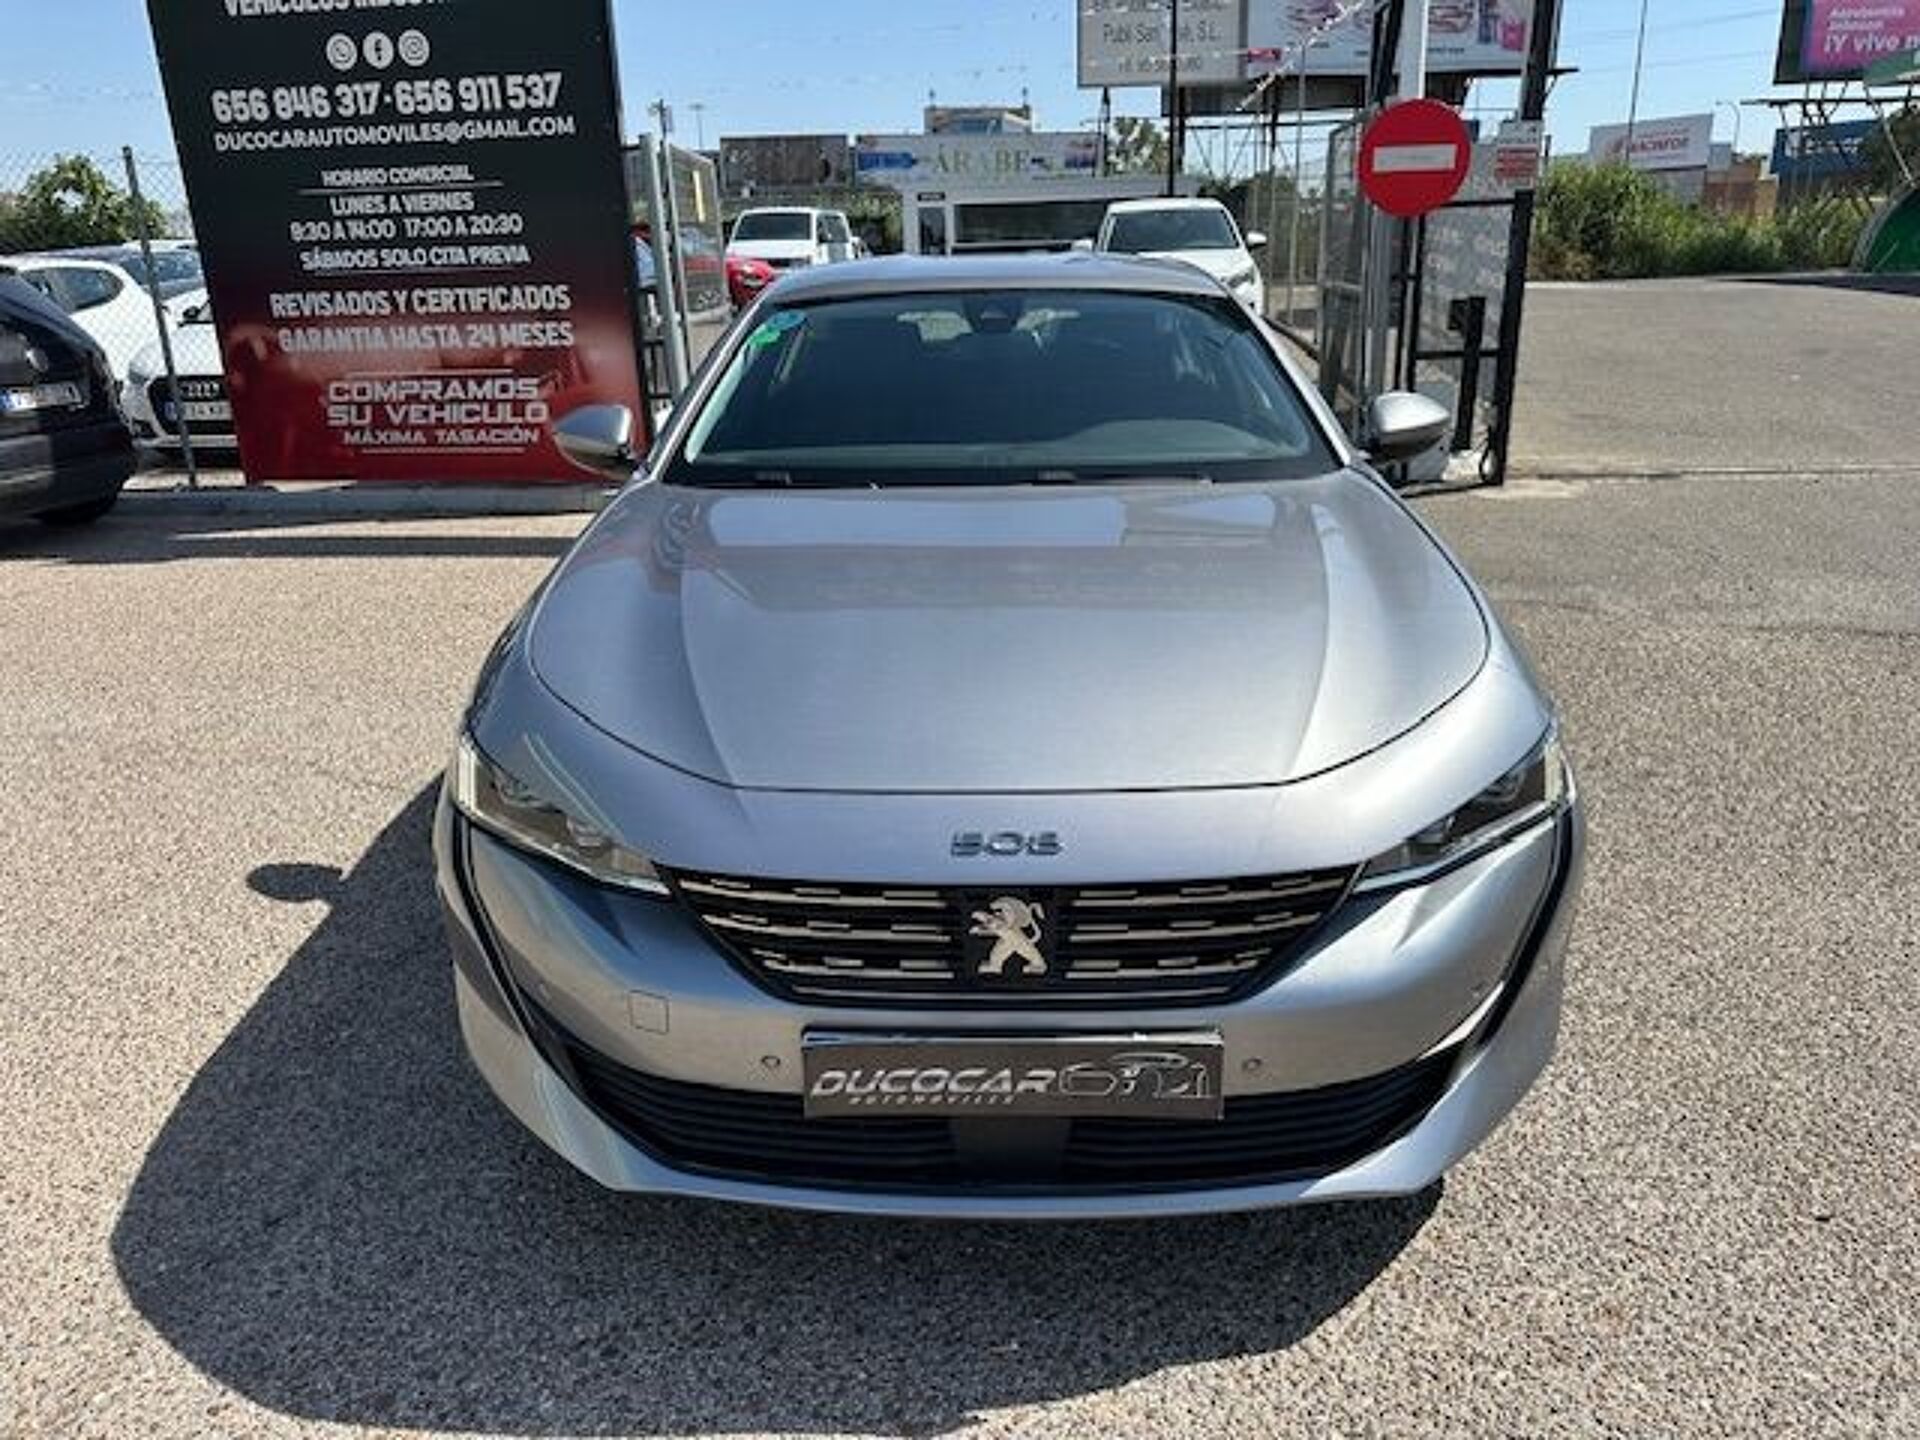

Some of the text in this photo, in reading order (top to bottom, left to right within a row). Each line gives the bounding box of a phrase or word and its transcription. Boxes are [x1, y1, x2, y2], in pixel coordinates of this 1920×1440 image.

[212, 88, 270, 123] 656
[273, 85, 331, 120] 846
[458, 75, 502, 111] 911
[505, 72, 562, 109] 537
[215, 115, 576, 151] DUCOCARAUTOMOVILES@GMAIL.COM
[321, 165, 474, 186] HORARIO COMERCIAL
[330, 191, 474, 216] LUNES A VIERNES
[290, 221, 330, 241] 8:30
[333, 220, 347, 240] A
[403, 216, 452, 237] 17:00
[455, 215, 468, 236] A
[468, 213, 523, 235] 20:30
[300, 244, 530, 270] SÁBADOS SOLO CITA PREVIA
[270, 284, 572, 318] REVISADOS Y CERTIFICADOS
[390, 323, 462, 350] HASTA
[466, 322, 496, 347] 24
[499, 321, 574, 347] MESES
[328, 377, 539, 402] COMPRAMOS
[326, 401, 549, 426] SU VEHICULO
[343, 425, 540, 445] MÁXIMA TASACIÓN
[811, 1069, 1057, 1096] DUCOCAR
